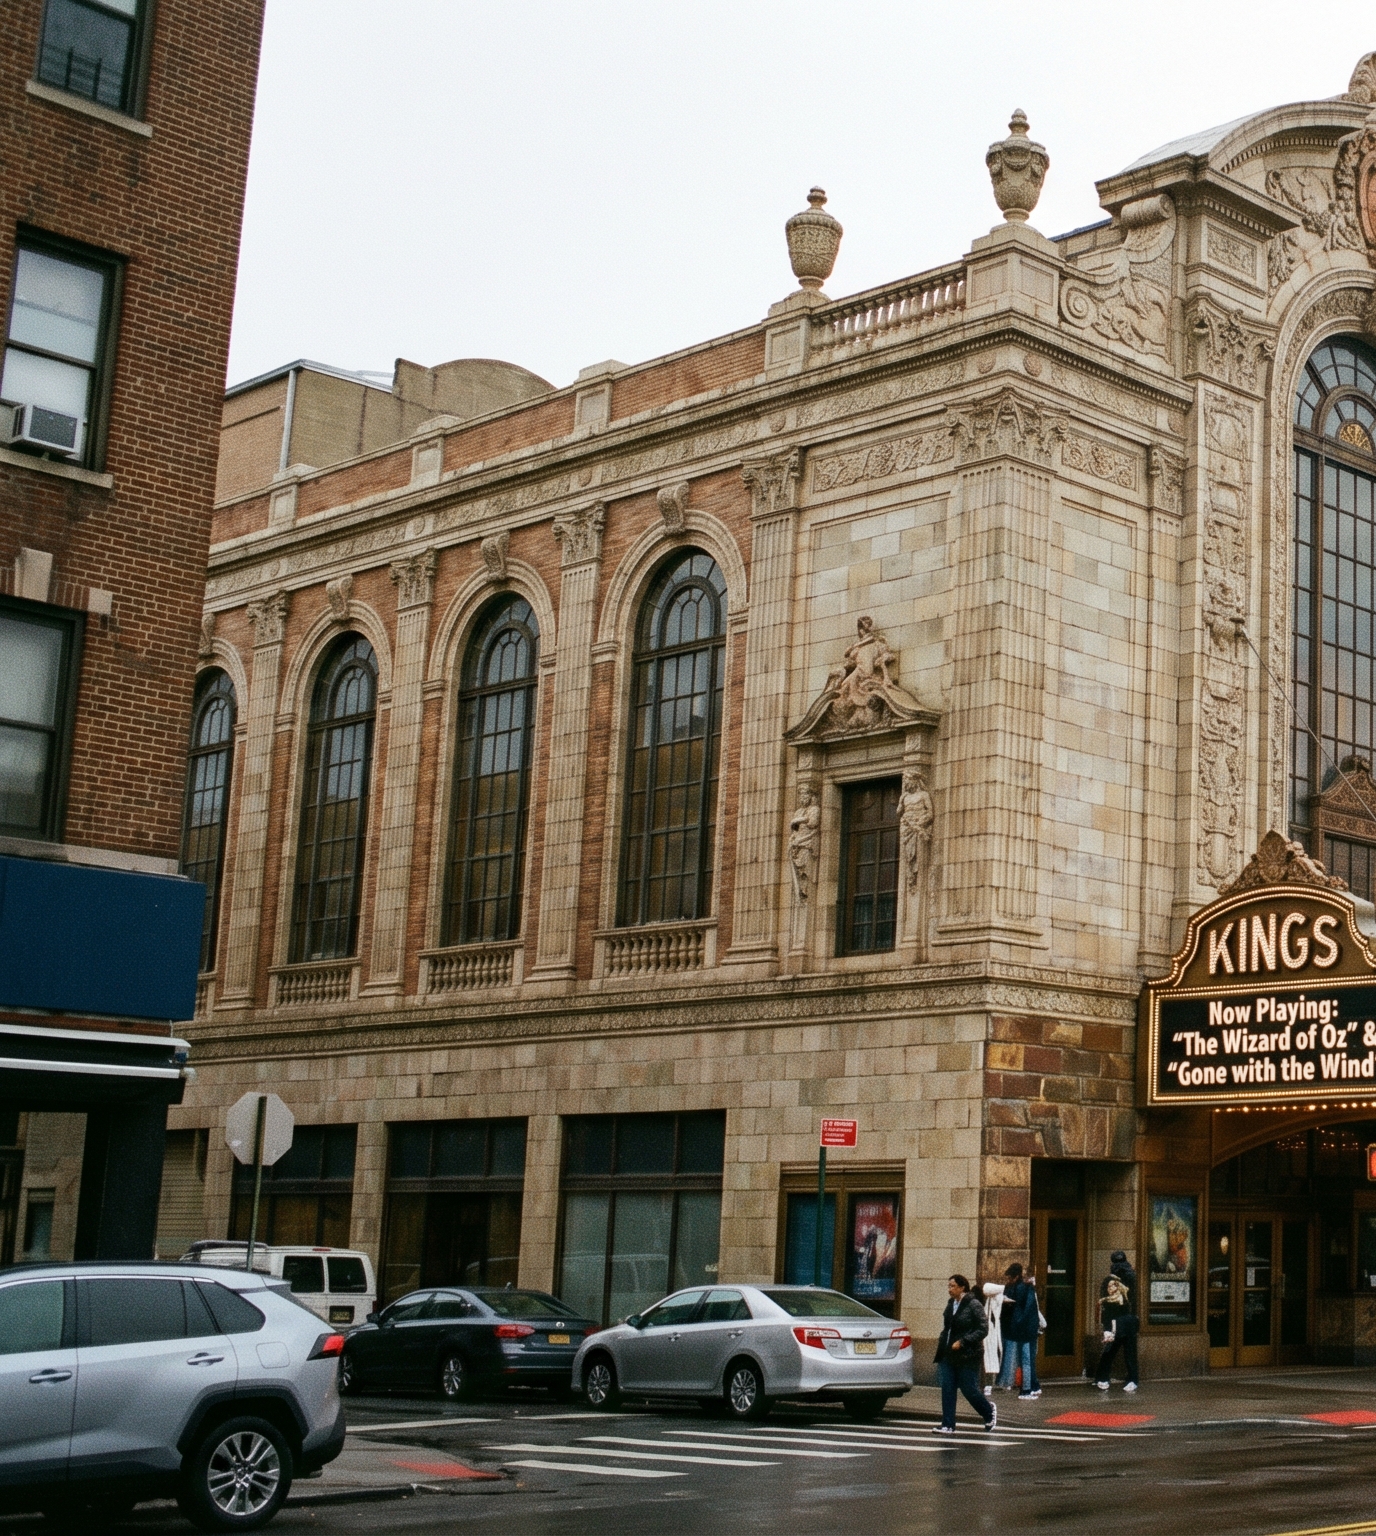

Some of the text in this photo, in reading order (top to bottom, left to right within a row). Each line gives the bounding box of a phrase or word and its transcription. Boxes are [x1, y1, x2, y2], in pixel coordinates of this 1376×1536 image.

[1208, 912, 1339, 975] KINGS
[1209, 994, 1338, 1026] Now Playing:
[1222, 1025, 1291, 1054] Wizard
[1296, 1023, 1317, 1050] of
[1231, 1057, 1276, 1082] with
[1281, 1055, 1315, 1081] the
